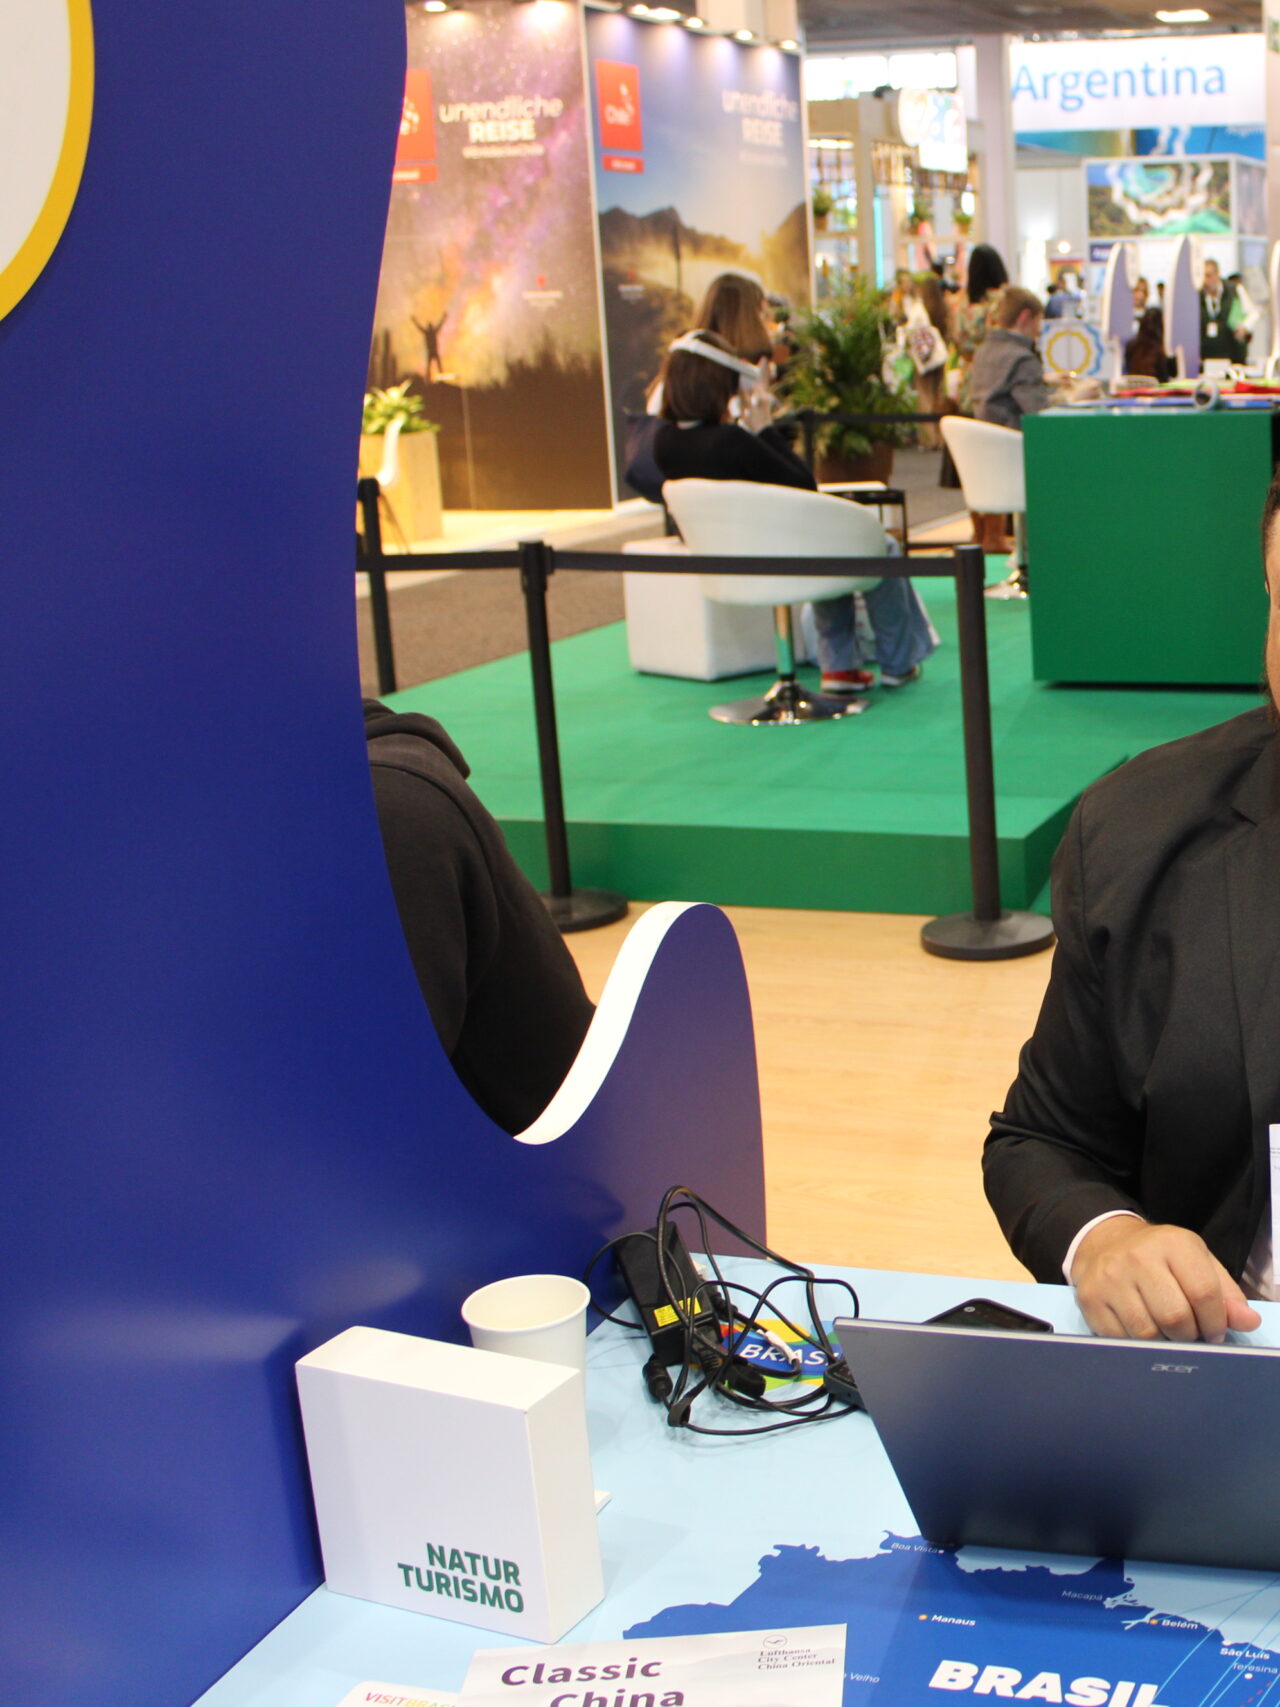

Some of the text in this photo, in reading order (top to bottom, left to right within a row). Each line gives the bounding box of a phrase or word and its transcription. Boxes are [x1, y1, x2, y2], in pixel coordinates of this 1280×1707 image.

[1011, 58, 1227, 112] Argentina
[439, 94, 564, 123] unendliche
[468, 118, 536, 143] REISE
[742, 118, 783, 147] REISE
[740, 1344, 839, 1366] BRAS
[1151, 1363, 1199, 1373] acer
[890, 1541, 912, 1551] Boa
[426, 1542, 522, 1586] NATUR
[397, 1562, 524, 1613] TURISMO
[931, 1614, 976, 1627] Manaus
[1161, 1618, 1198, 1631] Belém
[758, 1653, 817, 1664] City Center
[1219, 1647, 1243, 1657] São
[501, 1657, 663, 1687] Classic
[758, 1658, 835, 1670] China Oriental
[1233, 1662, 1278, 1675] Teresina
[849, 1671, 880, 1684] Velho
[928, 1659, 1171, 1707] BRASIL
[549, 1688, 686, 1707] China
